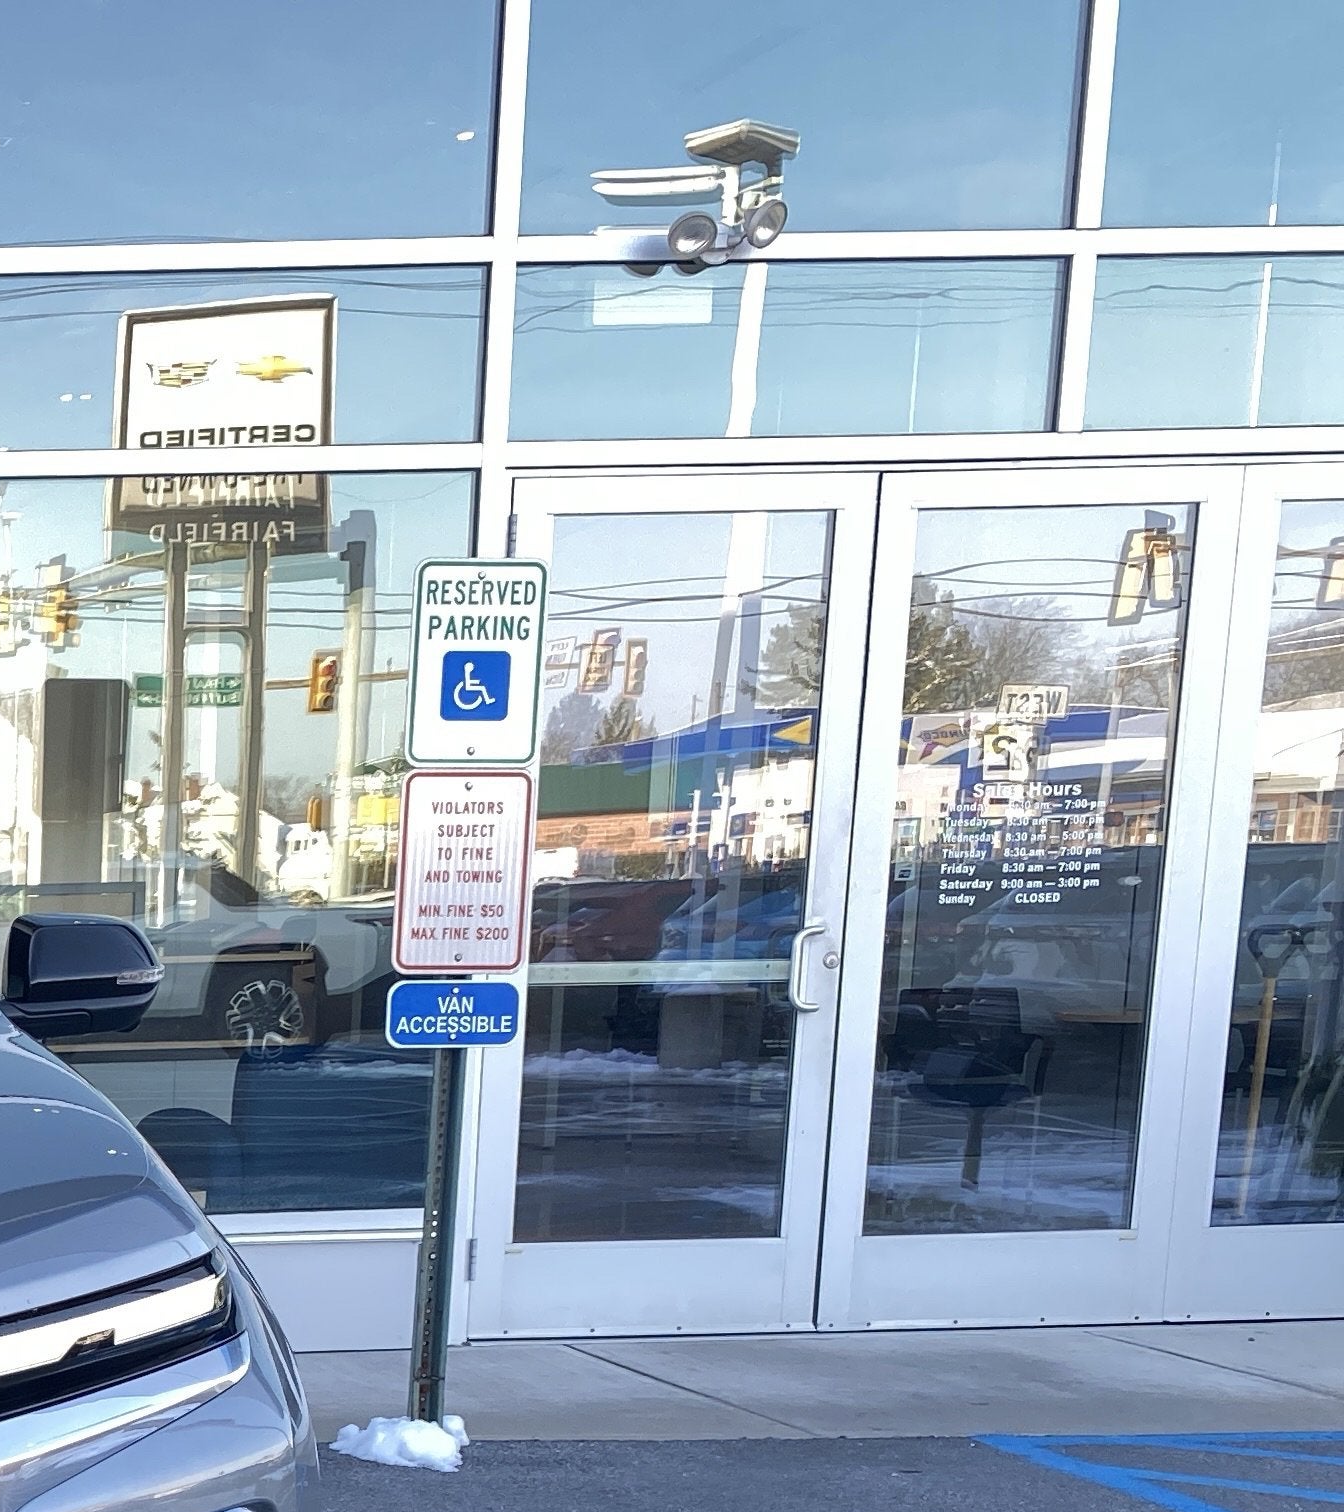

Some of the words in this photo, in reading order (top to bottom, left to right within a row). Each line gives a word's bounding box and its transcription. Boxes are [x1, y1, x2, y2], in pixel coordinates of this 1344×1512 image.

[426, 580, 536, 605] RESERVED
[428, 615, 530, 640] PARKING
[1029, 782, 1082, 796] Hours
[431, 802, 504, 814] VIOLATORS
[944, 817, 989, 829] Tuesday
[438, 824, 495, 837] SUBJECT
[942, 833, 995, 844] Wednesday
[438, 847, 452, 860] TO
[462, 847, 493, 860] FINE
[942, 849, 987, 860] Thursday
[1004, 848, 1027, 857] 8:30
[1060, 847, 1082, 856] 7:00
[1085, 848, 1102, 858] pm
[940, 864, 976, 876] Friday
[1002, 863, 1025, 872] 8:30
[1027, 864, 1044, 872] am
[1058, 862, 1081, 871] 7:00
[1083, 863, 1100, 873] pm
[425, 870, 450, 883] AND
[456, 870, 503, 883] TOWING
[939, 879, 993, 891] Saturday
[1000, 879, 1023, 889] 9:00
[1026, 880, 1042, 888] am
[1058, 878, 1081, 888] 3:00
[1083, 879, 1100, 889] pm
[938, 894, 976, 906] Sunday
[1015, 892, 1060, 904] CLOSED
[447, 904, 474, 918] FINE
[480, 904, 504, 918] $50
[442, 927, 470, 940] FINE
[476, 927, 509, 940] $200
[437, 996, 474, 1014] VAN
[395, 1015, 513, 1034] ACCESSIBLE
